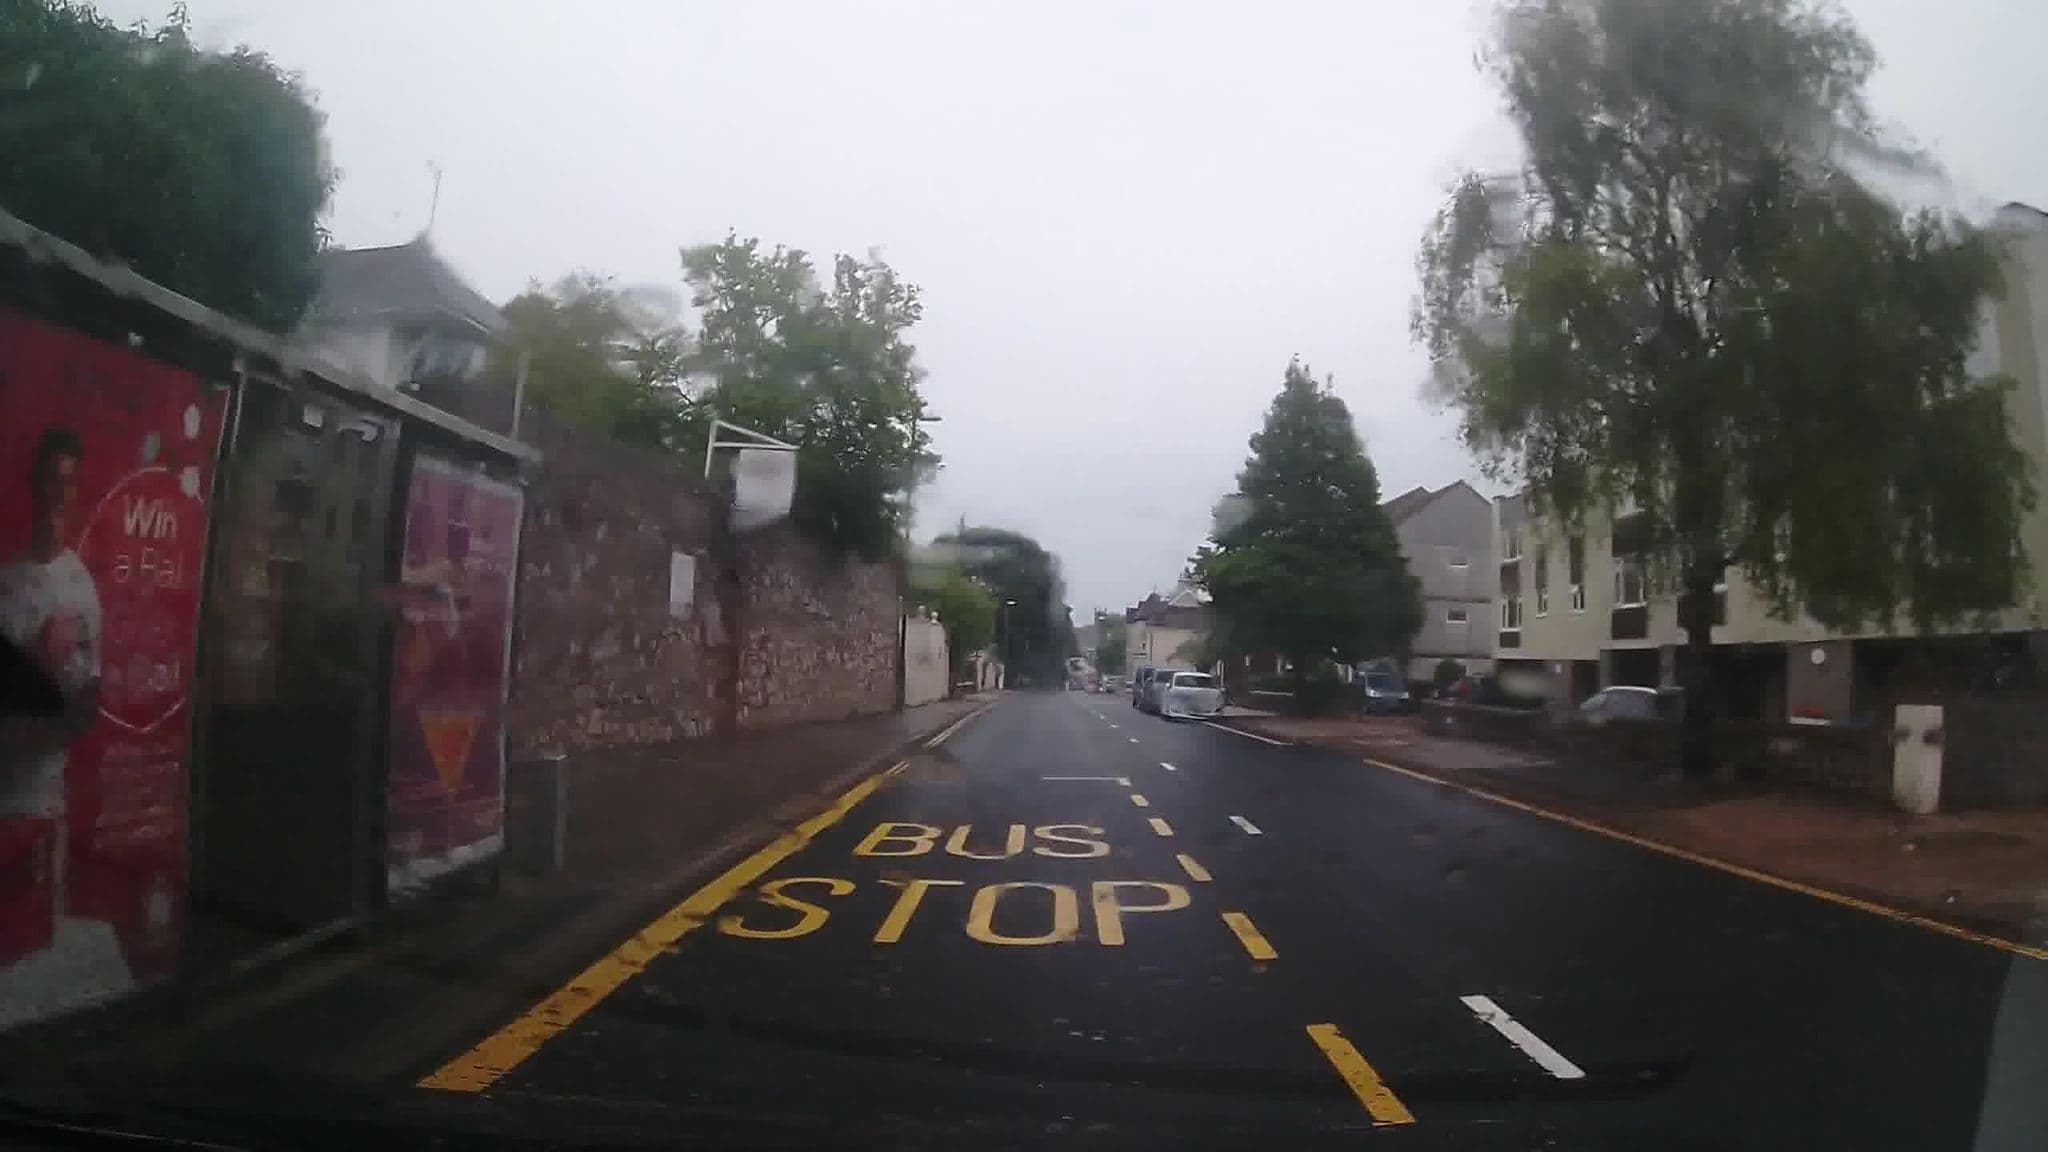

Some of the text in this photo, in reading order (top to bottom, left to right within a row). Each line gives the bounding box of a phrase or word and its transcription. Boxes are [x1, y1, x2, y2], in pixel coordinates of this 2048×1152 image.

[122, 494, 178, 539] Win
[852, 821, 1111, 861] BUS
[716, 876, 1193, 947] STOP
